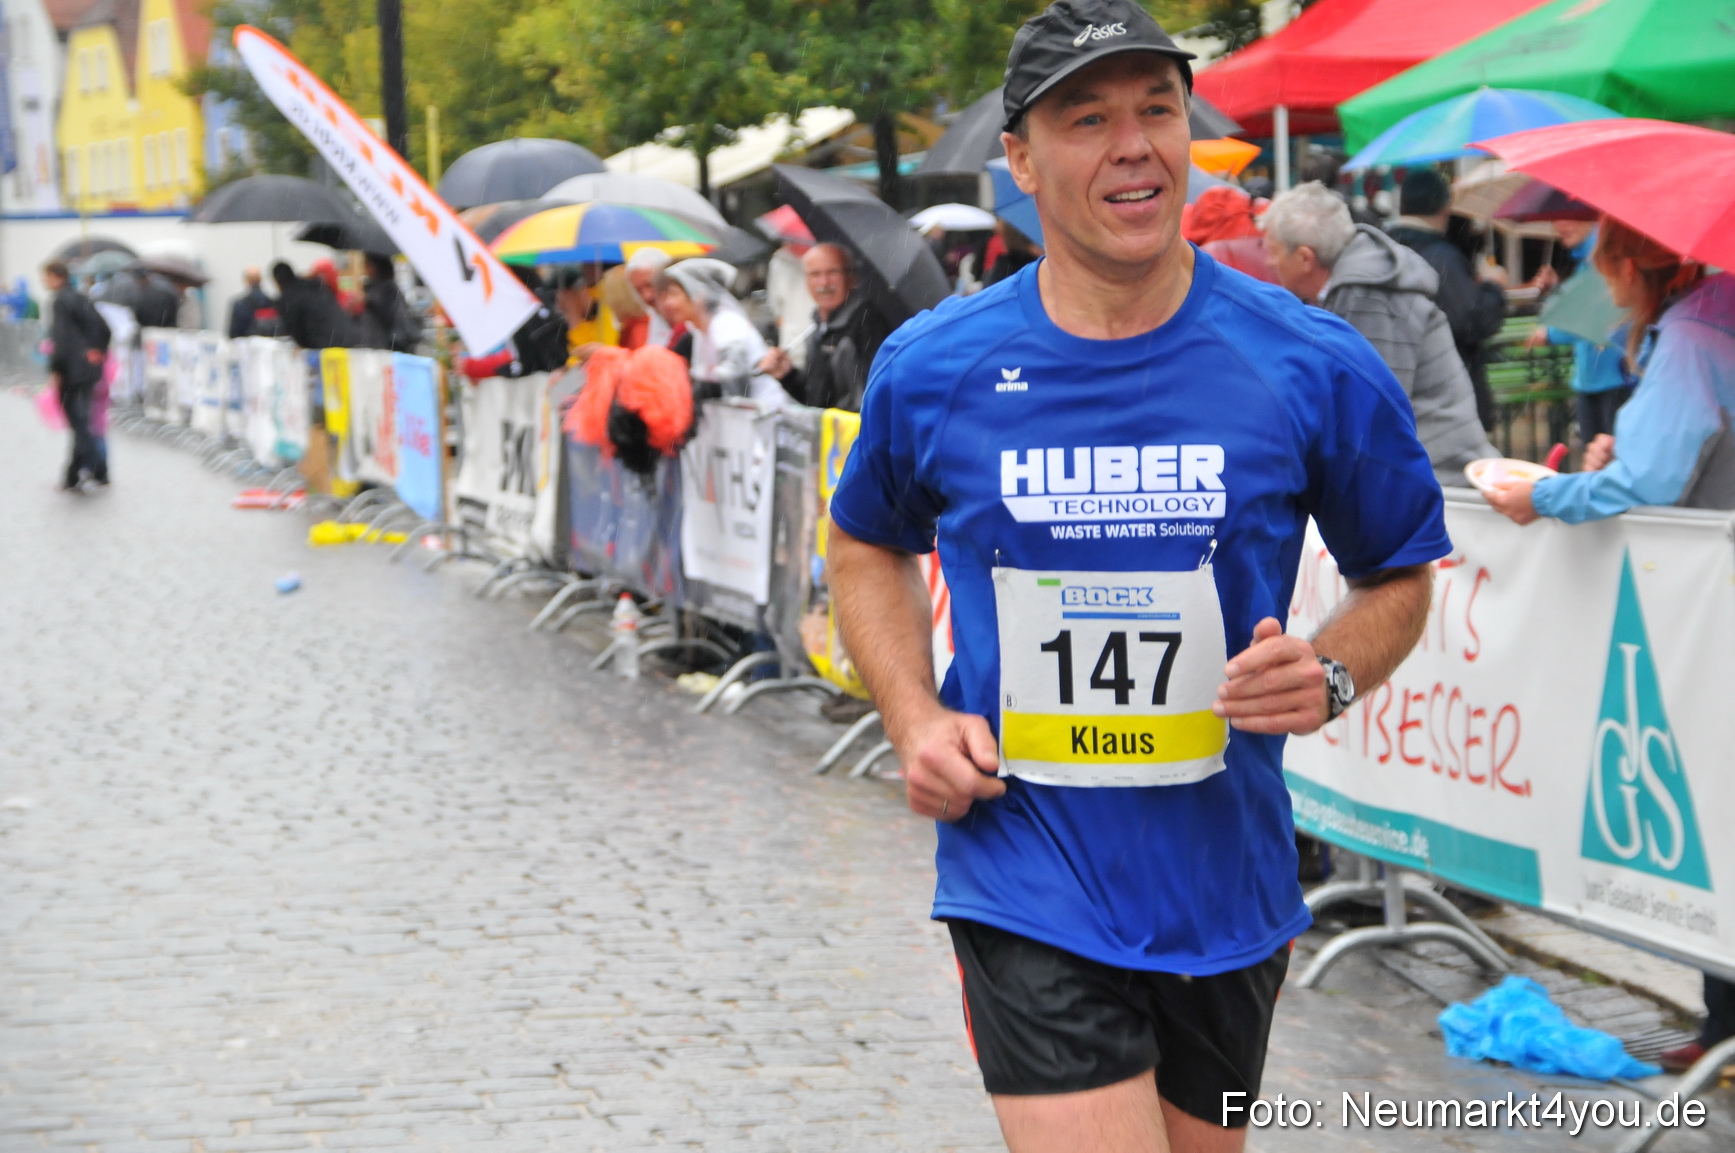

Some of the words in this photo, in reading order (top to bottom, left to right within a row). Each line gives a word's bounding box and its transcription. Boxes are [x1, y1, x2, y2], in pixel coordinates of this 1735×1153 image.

[1091, 22, 1127, 40] asics
[995, 381, 1028, 393] erima
[1001, 444, 1227, 496] HUBER
[1049, 497, 1216, 515] TECHNOLOGY
[1051, 525, 1102, 540] WASTE
[1105, 523, 1157, 538] WATER
[1160, 521, 1216, 537] Solutions
[1061, 586, 1155, 607] BOCK
[1040, 629, 1183, 706] 147
[1071, 725, 1156, 755] Klaus
